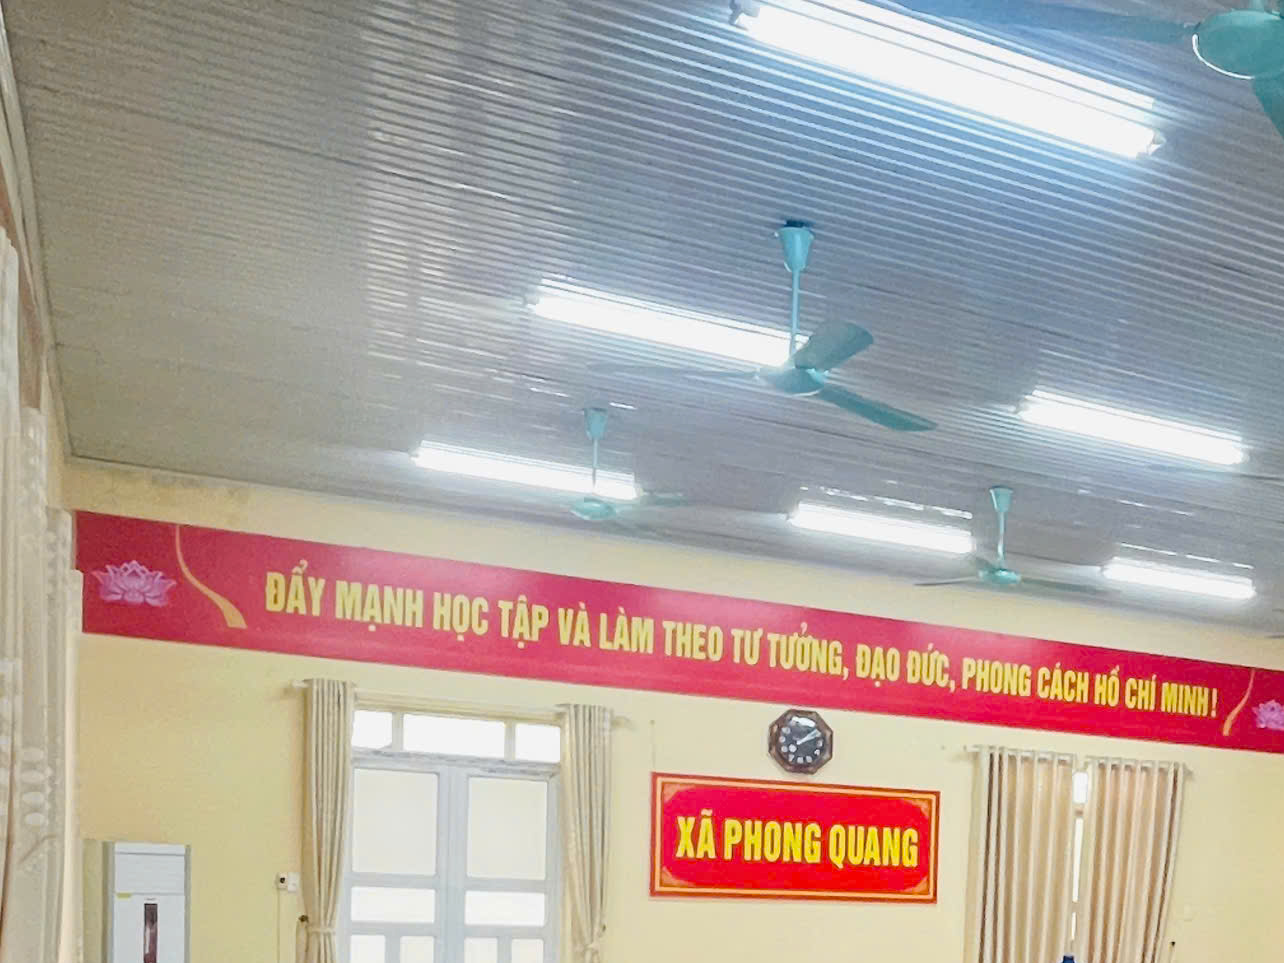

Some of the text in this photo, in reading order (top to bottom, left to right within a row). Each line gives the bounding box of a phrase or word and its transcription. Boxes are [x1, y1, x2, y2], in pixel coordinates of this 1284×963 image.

[265, 559, 1218, 718] ĐẨY MẠNH HỌC TẬP VÀ LÀM THEO TƯ TƯỞNG, ĐẠO ĐỨC, PHONG CÁCH HỒ CHÍ MINH!
[675, 808, 919, 869] XÃ PHONG QUANG
